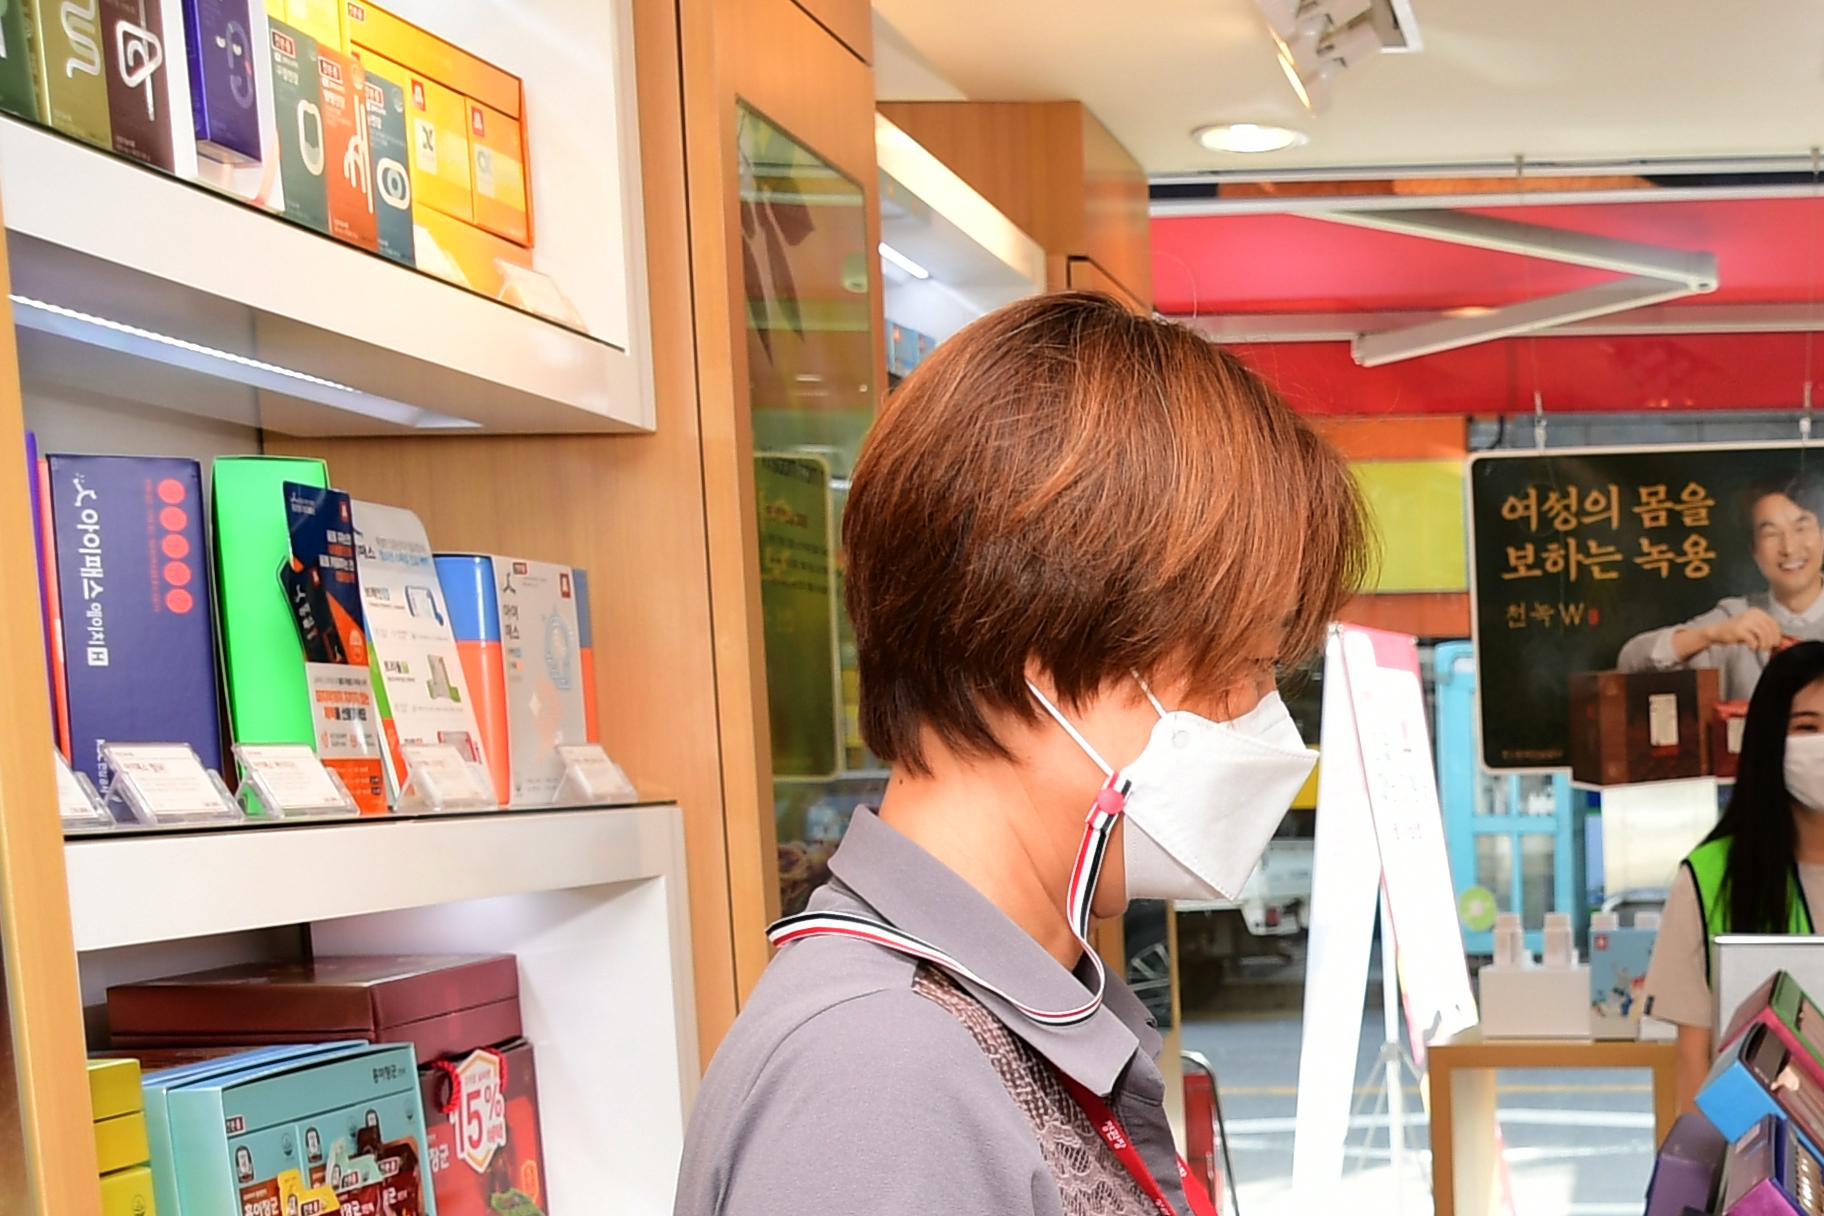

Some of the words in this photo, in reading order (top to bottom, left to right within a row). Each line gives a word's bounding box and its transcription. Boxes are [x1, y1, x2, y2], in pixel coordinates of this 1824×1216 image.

[1501, 483, 1621, 533] 여성의
[1631, 480, 1716, 529] 몸을
[75, 508, 105, 600] 아이패스
[1501, 536, 1623, 583] 보하는
[1632, 532, 1718, 580] 녹용
[87, 602, 107, 645] 에이치
